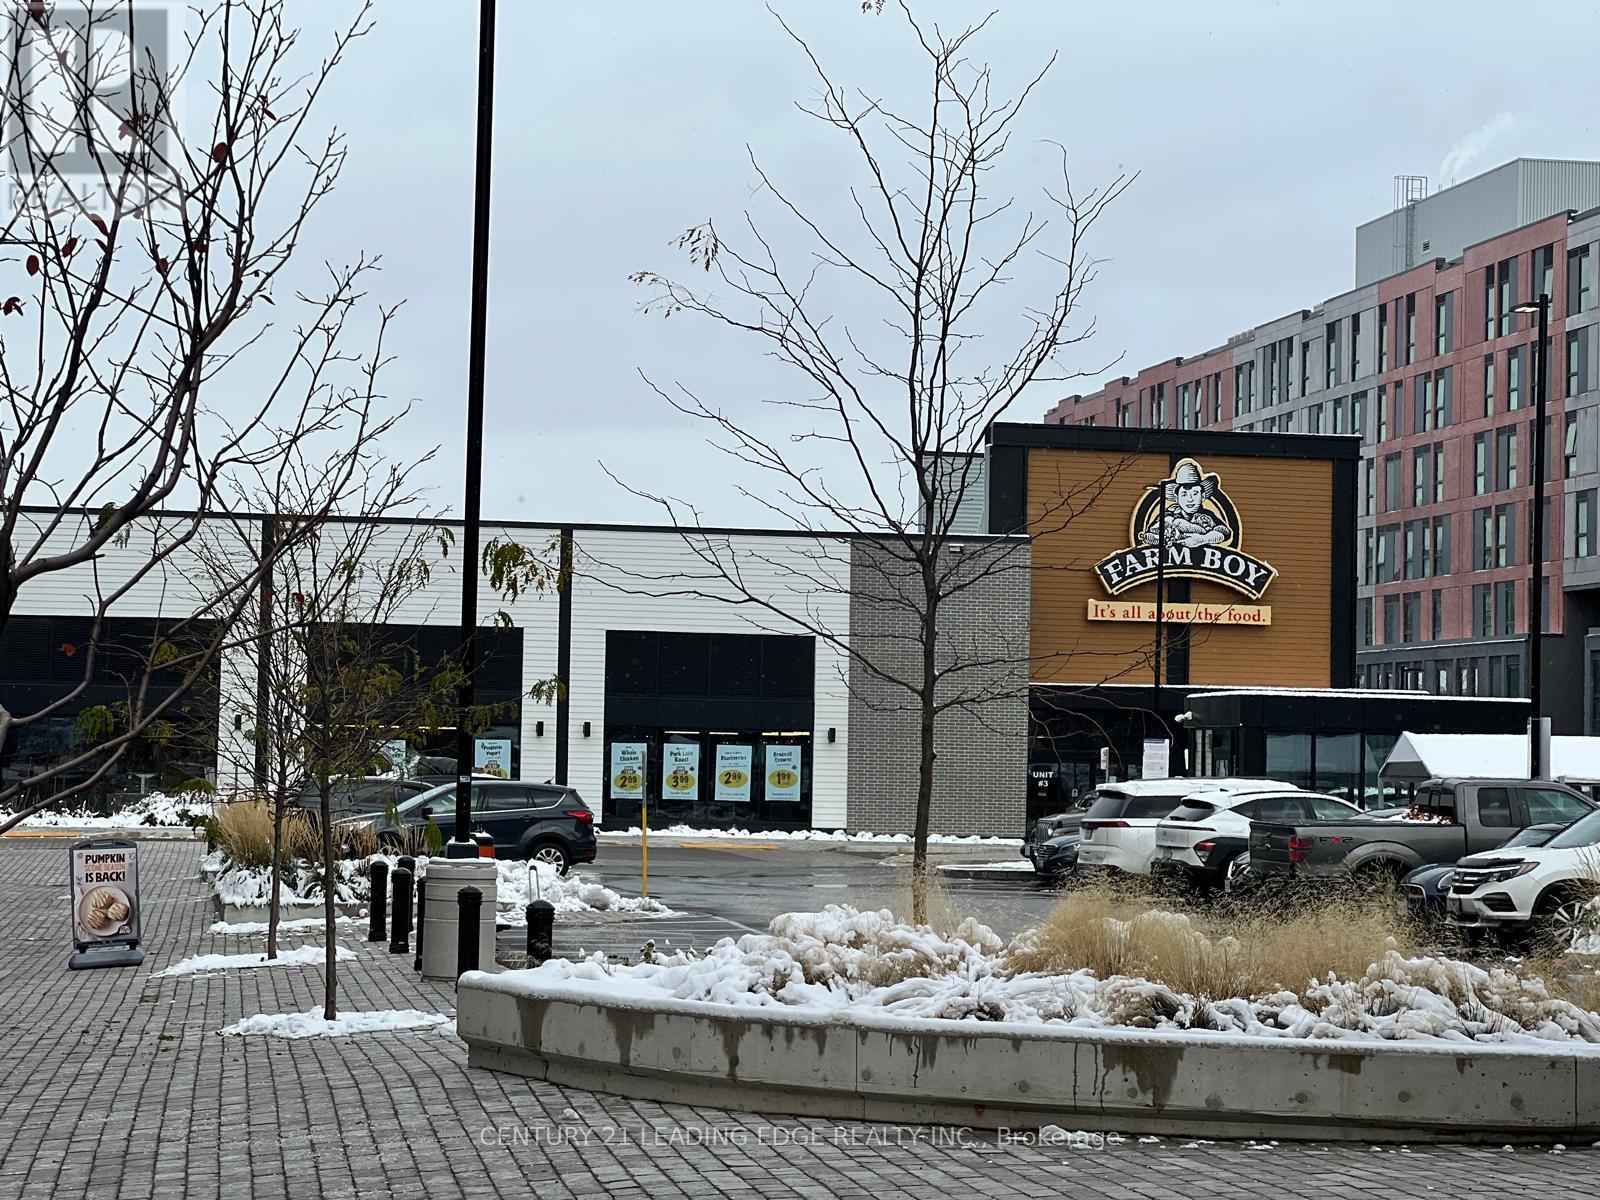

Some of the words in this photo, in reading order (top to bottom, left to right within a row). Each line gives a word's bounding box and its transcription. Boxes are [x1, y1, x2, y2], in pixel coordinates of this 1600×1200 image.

[1104, 547, 1193, 584] FARM
[1201, 547, 1267, 586] BOY
[1093, 604, 1116, 618] It's
[1123, 606, 1141, 619] all
[1197, 607, 1220, 621] the
[1228, 608, 1266, 623] food.
[85, 853, 125, 864] PUMPKIN
[85, 872, 94, 883] IS
[96, 871, 125, 882] BACK!
